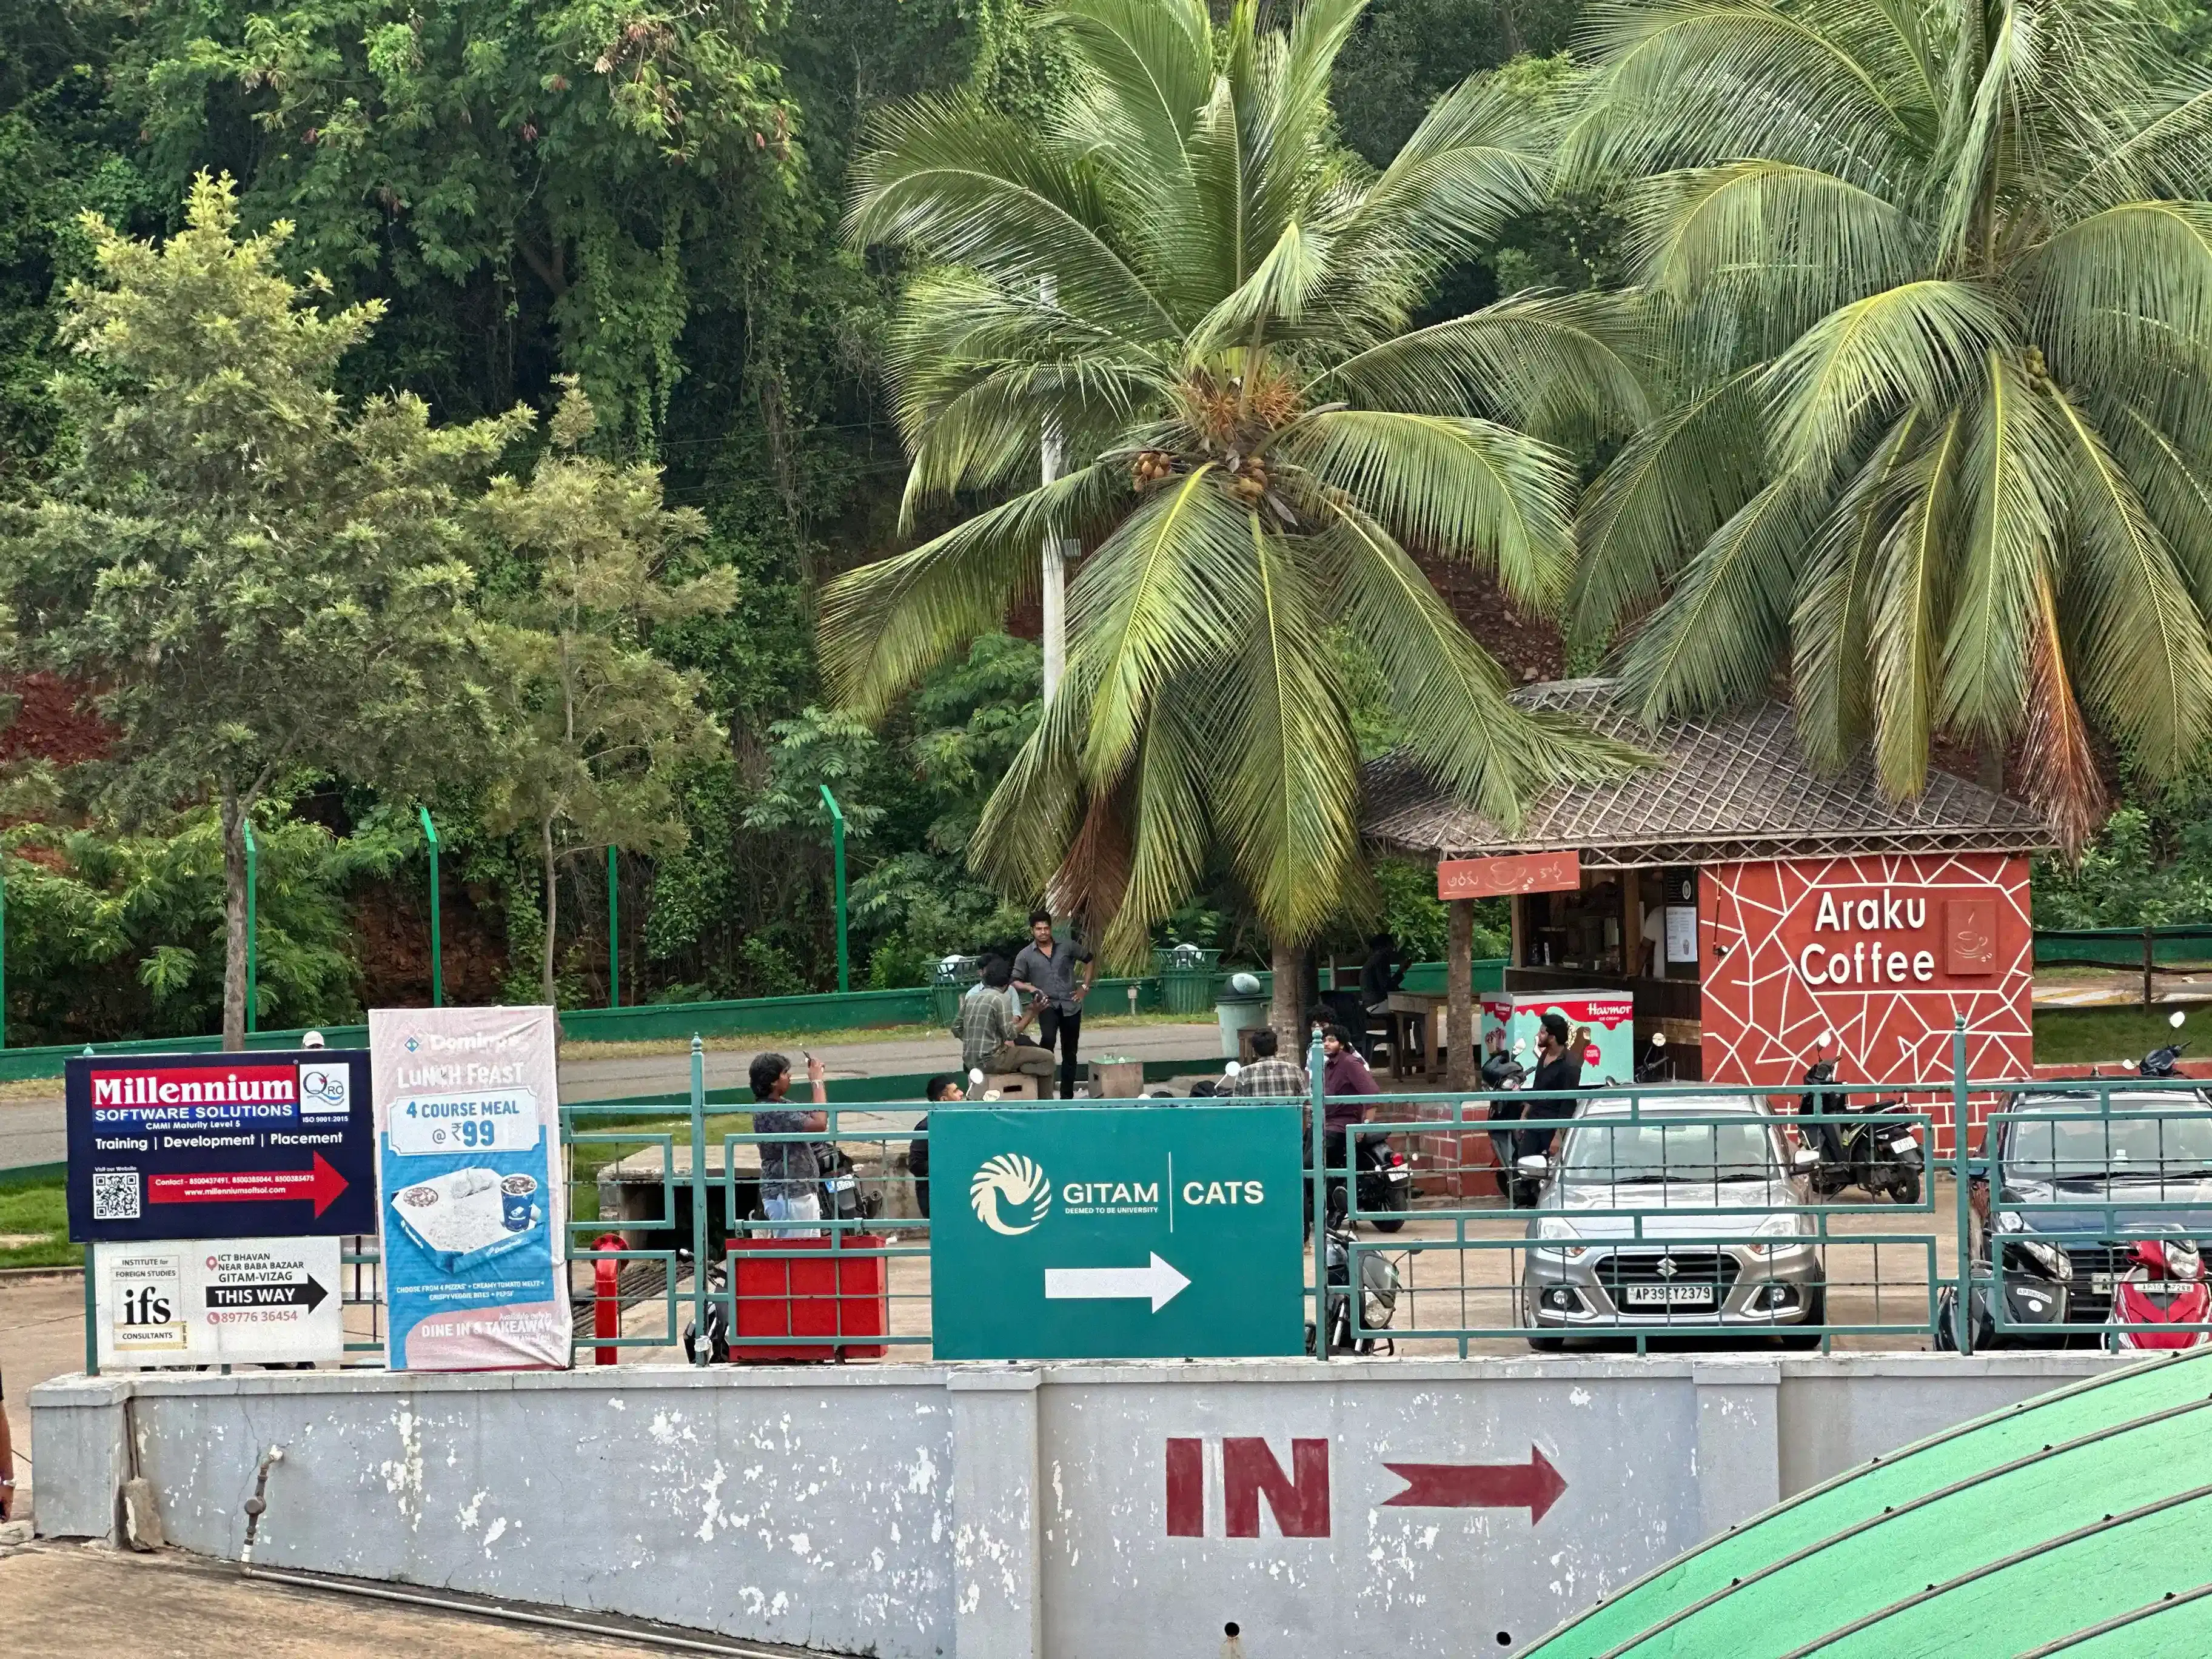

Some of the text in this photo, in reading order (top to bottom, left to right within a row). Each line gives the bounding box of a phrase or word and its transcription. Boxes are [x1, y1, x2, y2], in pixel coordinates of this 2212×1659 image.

[1815, 889, 1926, 932] Araku
[1800, 942, 1935, 985] Coffee
[1586, 1003, 1632, 1016] Havmor
[94, 1073, 295, 1105] Millennium
[95, 1104, 293, 1122] SOFTWARE SOLUTIONS
[406, 1100, 520, 1118] 4 COURSE MEAL
[146, 1122, 170, 1130] CMMI
[172, 1121, 208, 1131] Maturity
[210, 1120, 233, 1128] Level
[432, 1120, 495, 1148] @ ₹99
[95, 1131, 343, 1151] Training Development Placement
[1063, 1180, 1265, 1205] GITAM CATS
[218, 1253, 270, 1262] ICT BHAVAN
[270, 1261, 304, 1270] BAZAAR
[218, 1272, 293, 1283] GITAM-VIZAG
[215, 1288, 296, 1304] THIS WAY
[123, 1286, 172, 1326] ifs
[221, 1310, 299, 1323] 89776 36454
[122, 1332, 173, 1340] CONSULTANTS
[421, 1322, 454, 1338] DINE
[484, 1318, 552, 1335] TAKEAWAY
[1166, 1436, 1331, 1538] IN
